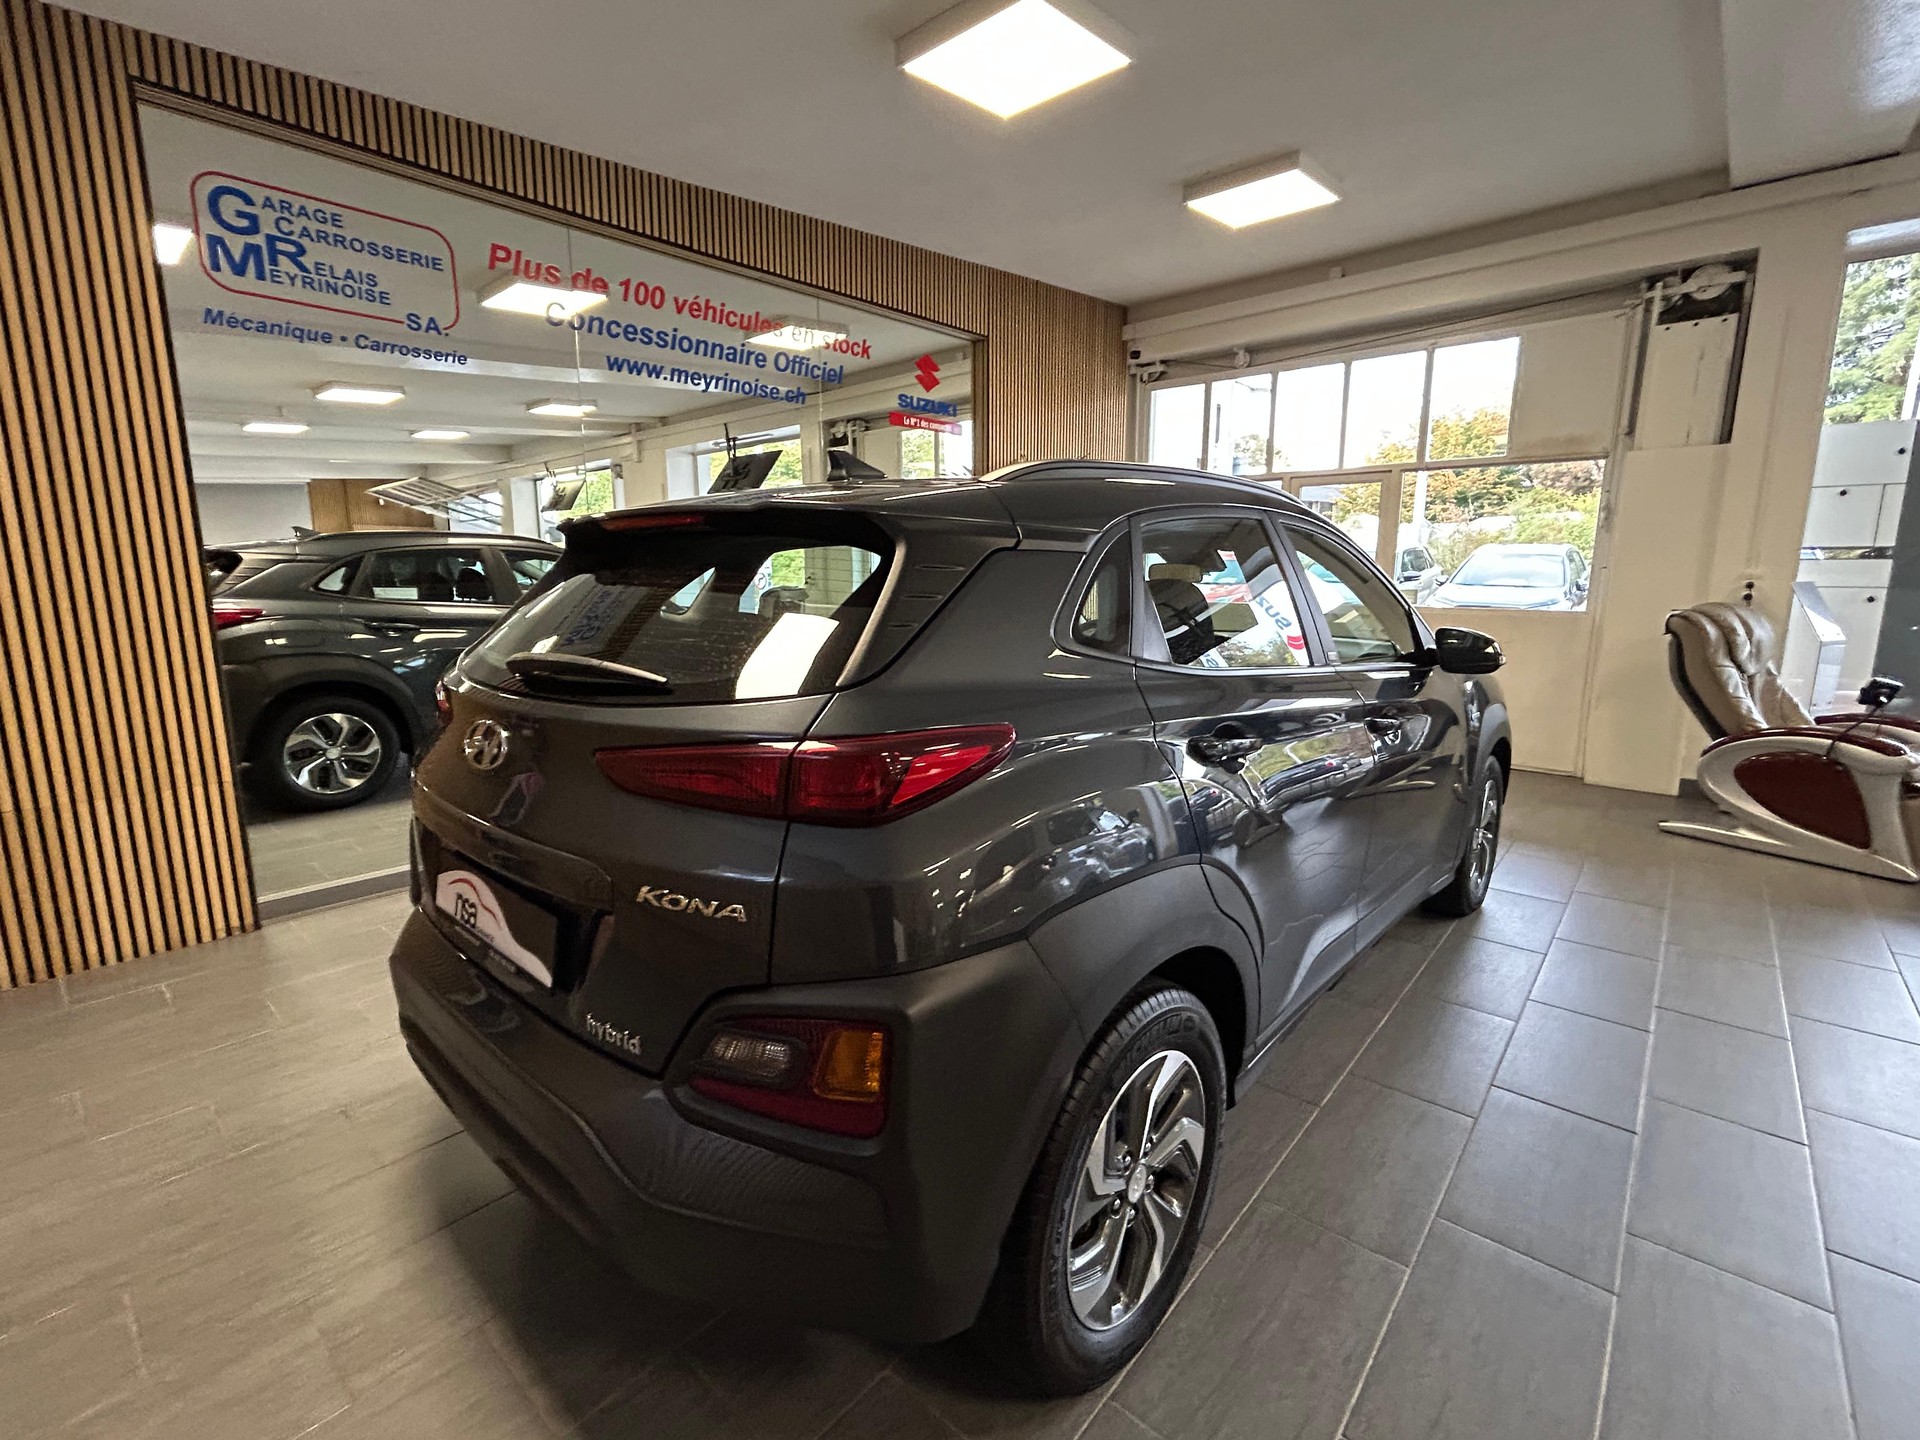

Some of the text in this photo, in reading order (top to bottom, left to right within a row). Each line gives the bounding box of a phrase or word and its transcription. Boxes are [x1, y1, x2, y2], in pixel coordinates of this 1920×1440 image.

[206, 233, 391, 306] MEYRINOISE
[265, 233, 378, 287] RELAIS
[274, 215, 444, 272] CARROSSERIE
[488, 243, 872, 360] Plus de 100 véhicules en stock
[203, 307, 467, 365] Mécanique Carrosserie
[546, 302, 844, 384] Concessionnaire Officiel
[606, 355, 806, 404] www.meyrinoise.ch
[636, 885, 746, 922] KONA
[587, 1012, 641, 1055] hybrid
